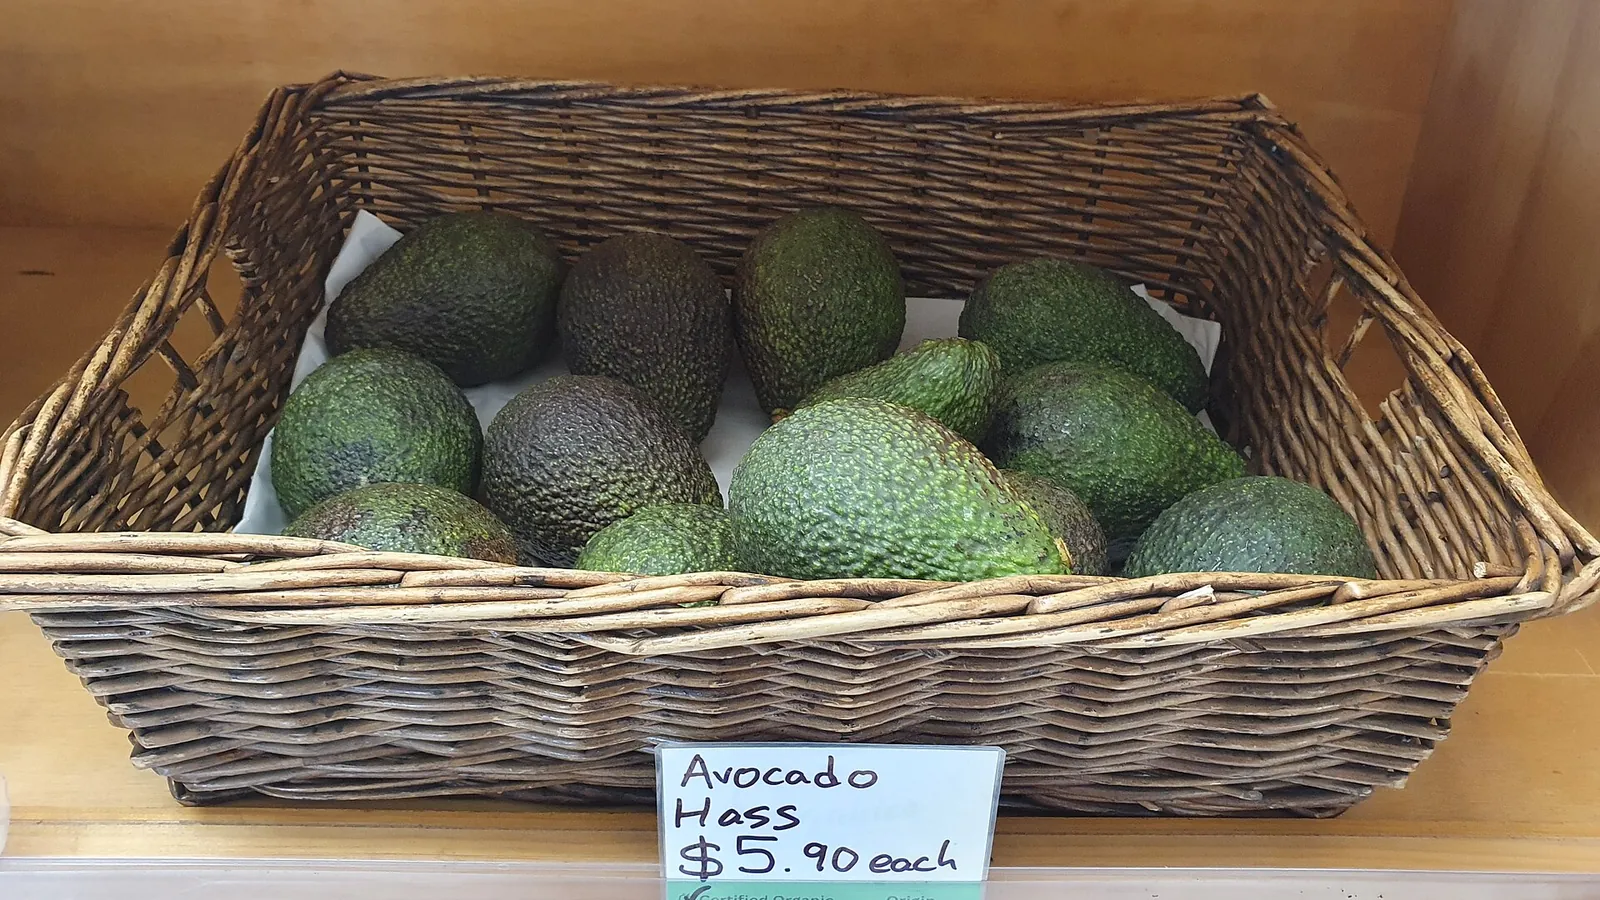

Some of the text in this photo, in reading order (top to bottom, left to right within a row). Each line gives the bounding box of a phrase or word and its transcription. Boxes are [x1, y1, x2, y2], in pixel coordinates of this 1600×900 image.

[680, 754, 878, 790] Avocado
[675, 797, 801, 831] Hass
[678, 836, 957, 881] $5.90 each
